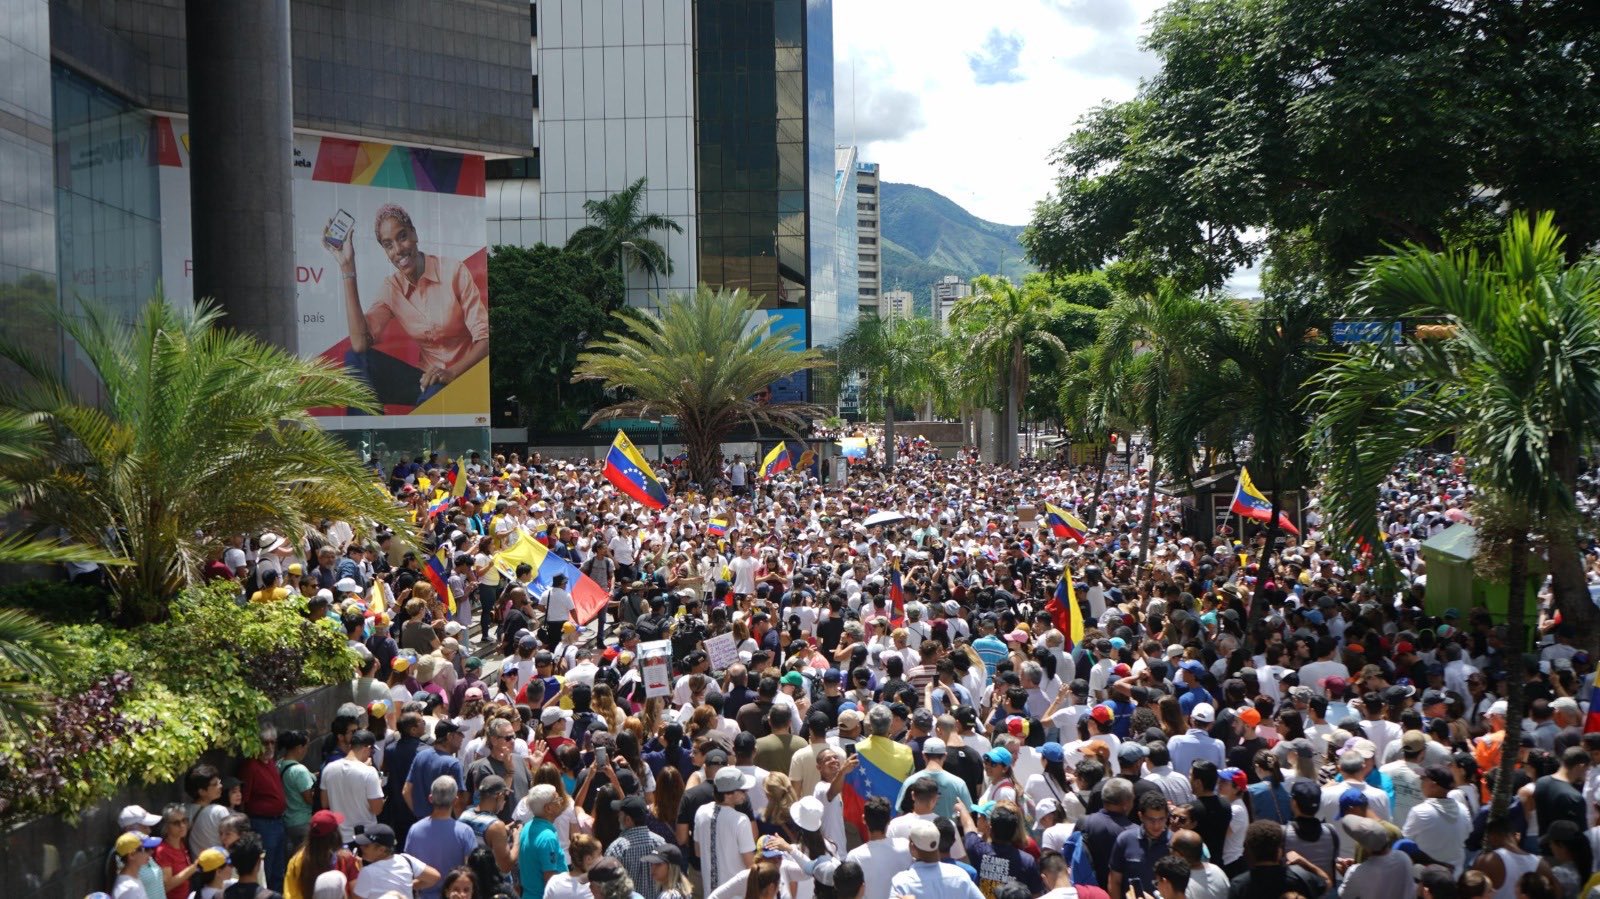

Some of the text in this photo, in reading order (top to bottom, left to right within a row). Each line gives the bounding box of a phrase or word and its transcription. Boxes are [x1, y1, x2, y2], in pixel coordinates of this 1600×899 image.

[297, 266, 324, 284] DV
[304, 312, 325, 324] país
[981, 854, 1010, 865] SEAMOS
[980, 863, 1010, 875] QUIENES
